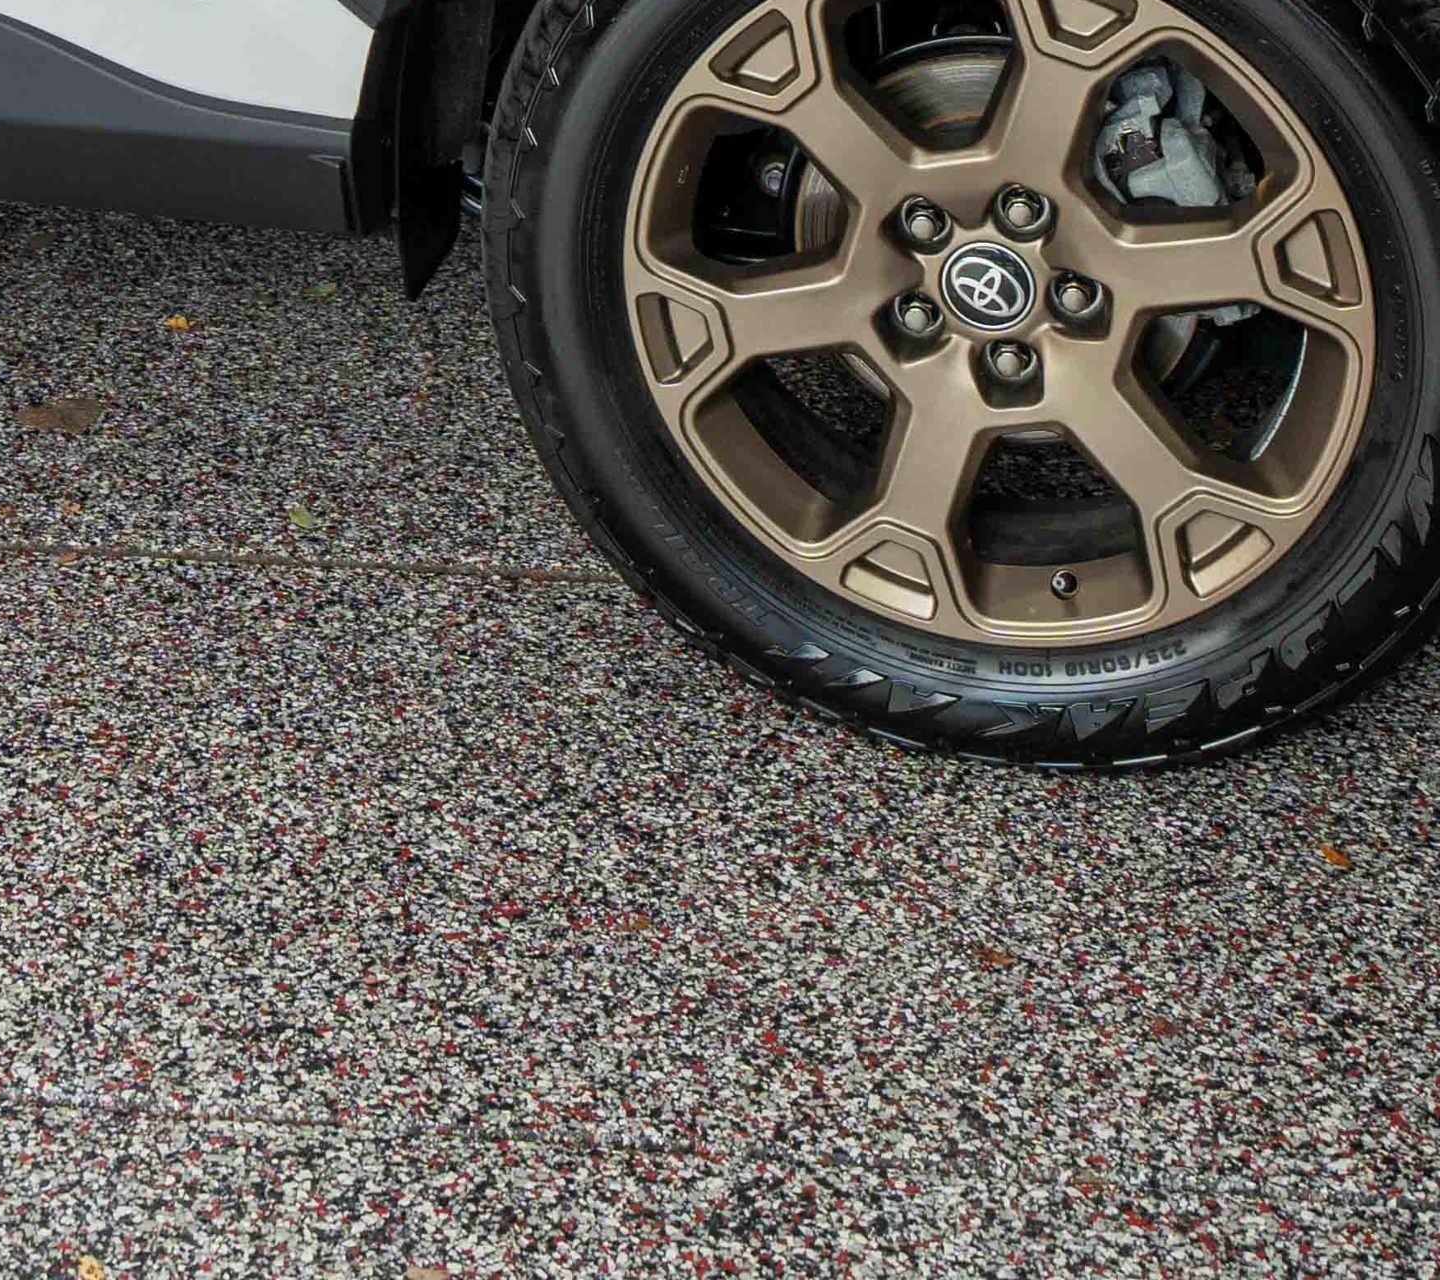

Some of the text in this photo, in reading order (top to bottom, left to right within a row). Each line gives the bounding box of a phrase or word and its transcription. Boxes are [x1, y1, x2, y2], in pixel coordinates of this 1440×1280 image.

[975, 433, 1436, 741] WILDPEAK
[998, 639, 1188, 678] 225/60R18 100H
